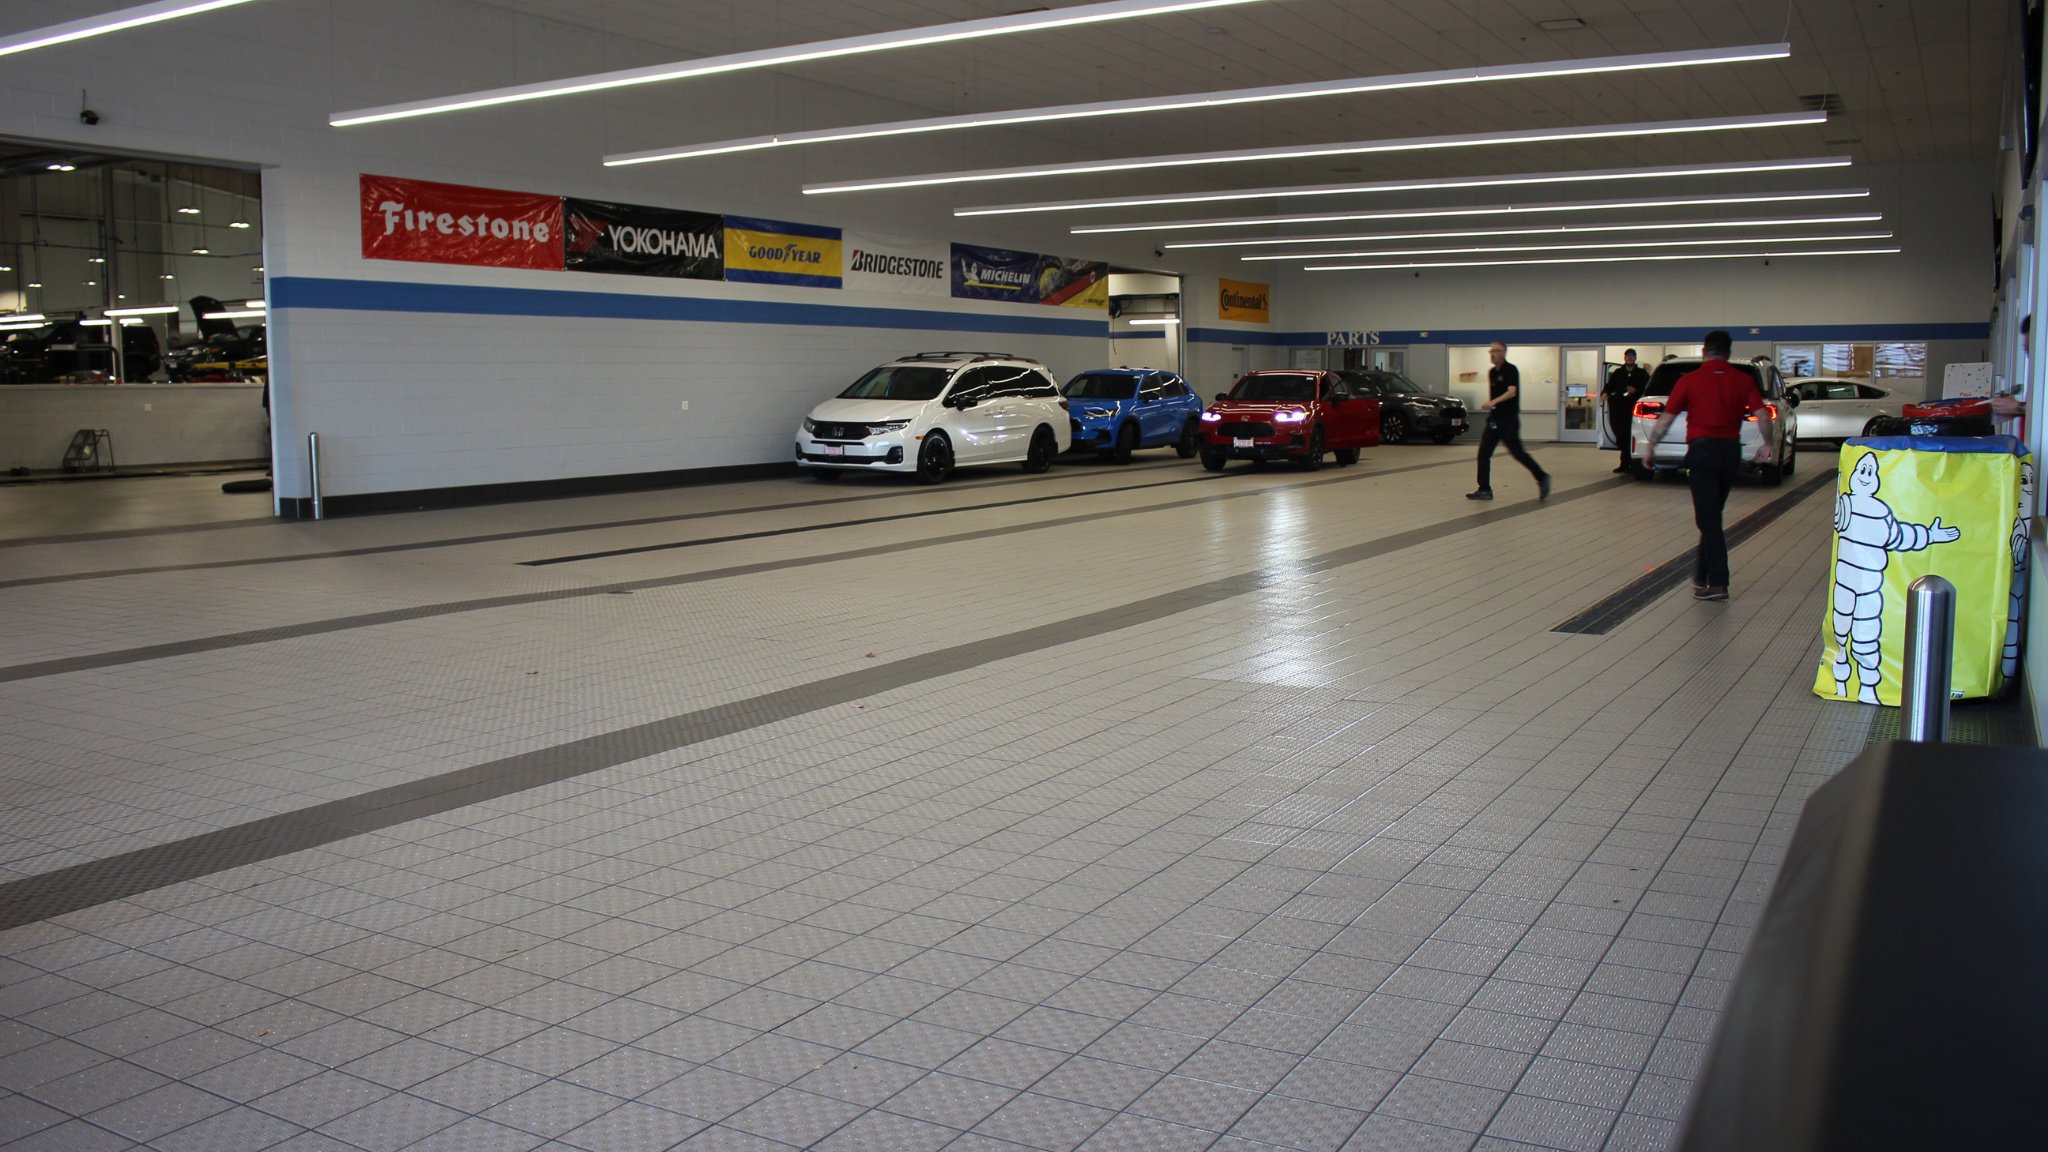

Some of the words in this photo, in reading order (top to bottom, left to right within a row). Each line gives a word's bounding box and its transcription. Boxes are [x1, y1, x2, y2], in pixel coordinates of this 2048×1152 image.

[379, 201, 549, 243] Firestone
[608, 225, 719, 259] YOKOHAMA
[749, 244, 821, 264] GOODYEAR
[851, 249, 944, 279] BRIDGESTONE
[981, 269, 1031, 284] MICHELIN
[1221, 288, 1262, 311] Continental
[1327, 331, 1380, 346] PARTS
